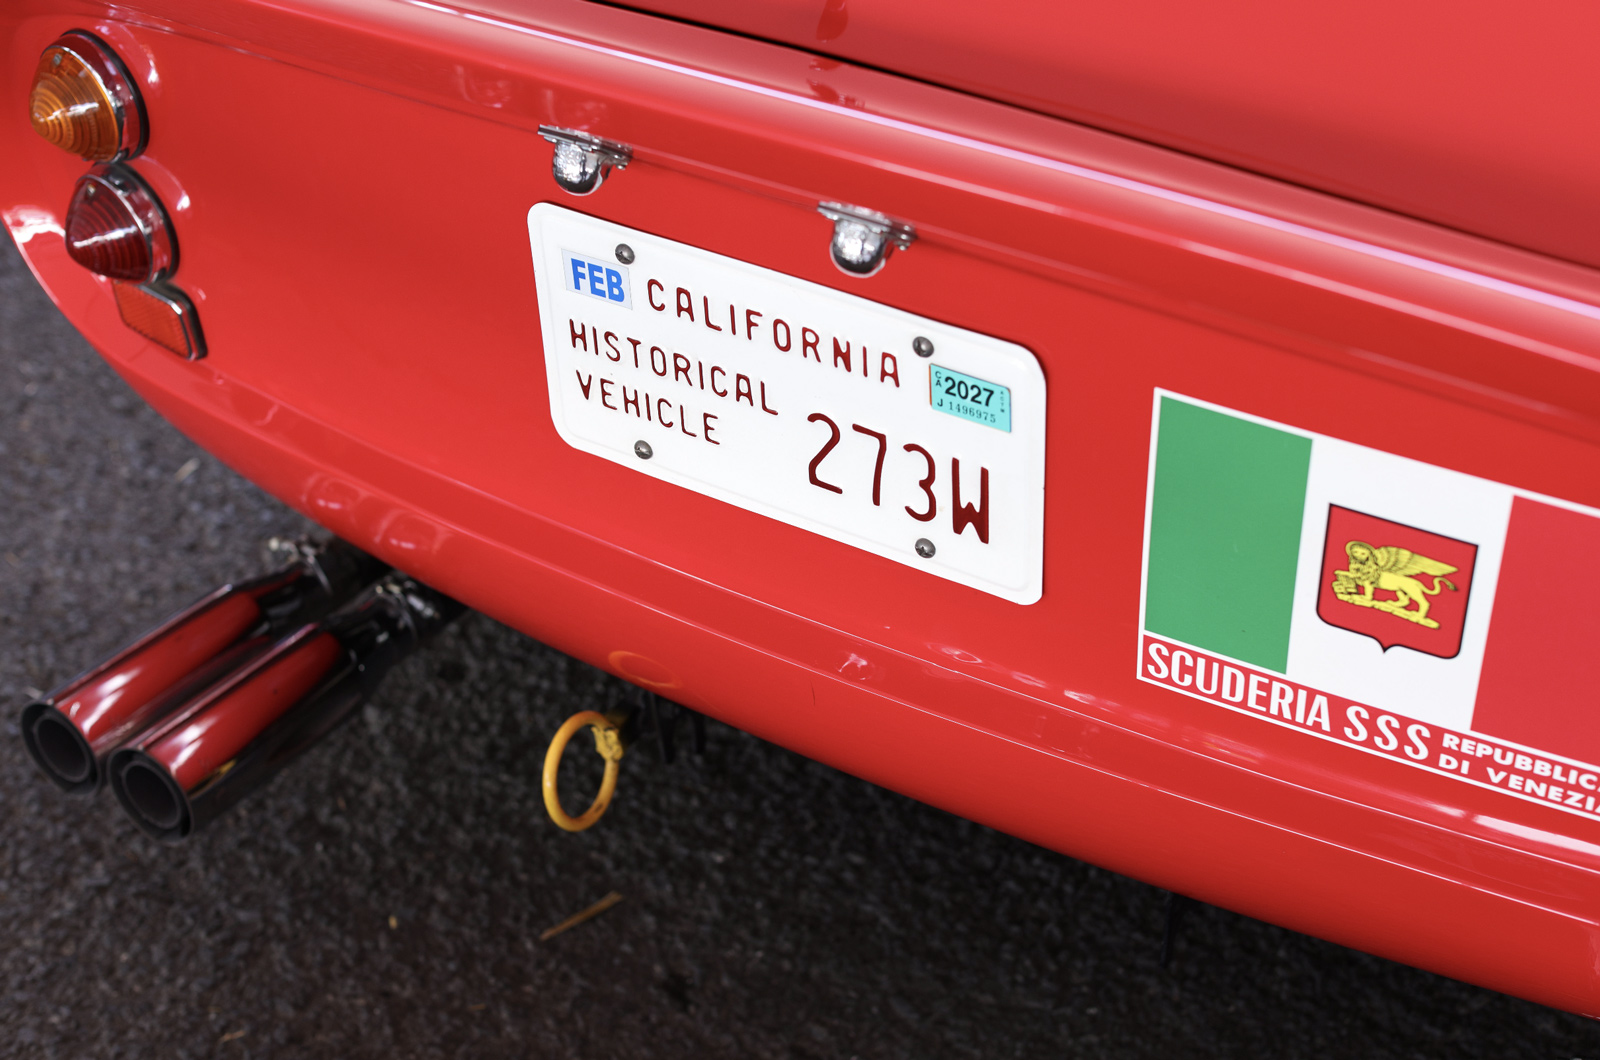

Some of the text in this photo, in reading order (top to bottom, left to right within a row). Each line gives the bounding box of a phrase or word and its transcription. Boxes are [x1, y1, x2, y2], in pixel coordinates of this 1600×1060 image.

[570, 257, 625, 303] FEB
[568, 318, 779, 416] HISTORICAL
[646, 278, 901, 388] CALIFORNIA
[576, 370, 720, 445] VEHICLE
[945, 376, 994, 407] 2027
[806, 412, 990, 545] 273W
[1146, 642, 1332, 732] SCUDERIA
[1438, 753, 1470, 775] DI
[1442, 733, 1600, 792] REPUBBLIC
